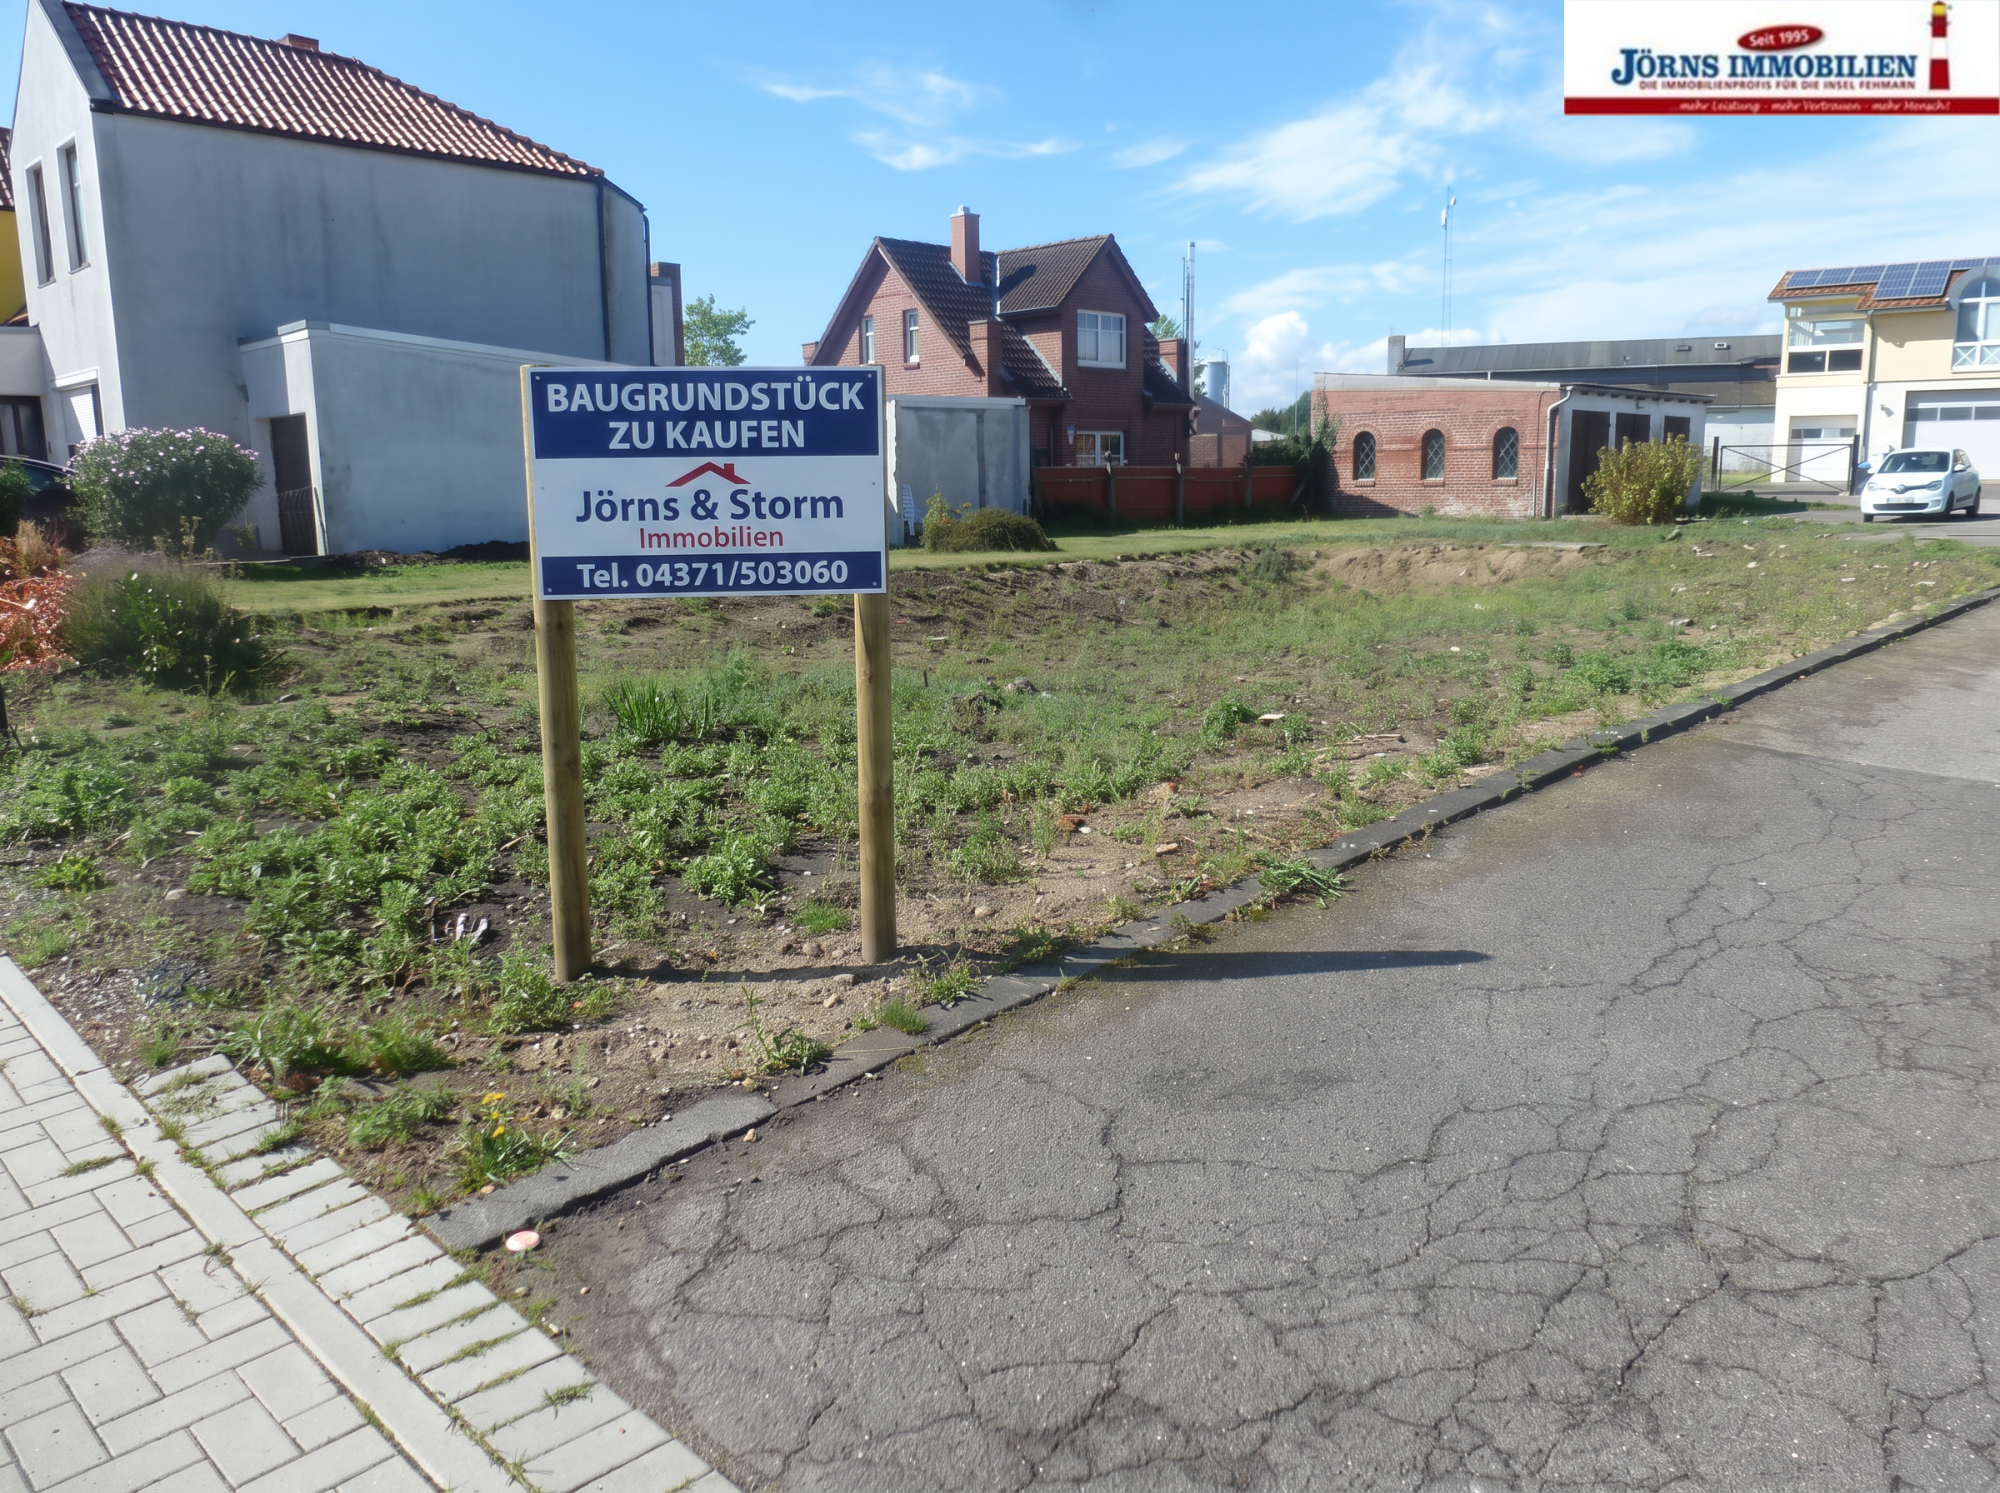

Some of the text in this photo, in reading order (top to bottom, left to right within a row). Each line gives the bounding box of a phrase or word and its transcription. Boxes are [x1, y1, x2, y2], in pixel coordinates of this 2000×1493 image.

[547, 375, 865, 412] BAUGRUNDSTÜCK
[608, 420, 805, 450] ZU KAUFEN
[576, 489, 844, 522] Jörns & Storm
[640, 526, 784, 549] Immobilien
[577, 560, 849, 588] Tel. 04371/503060
